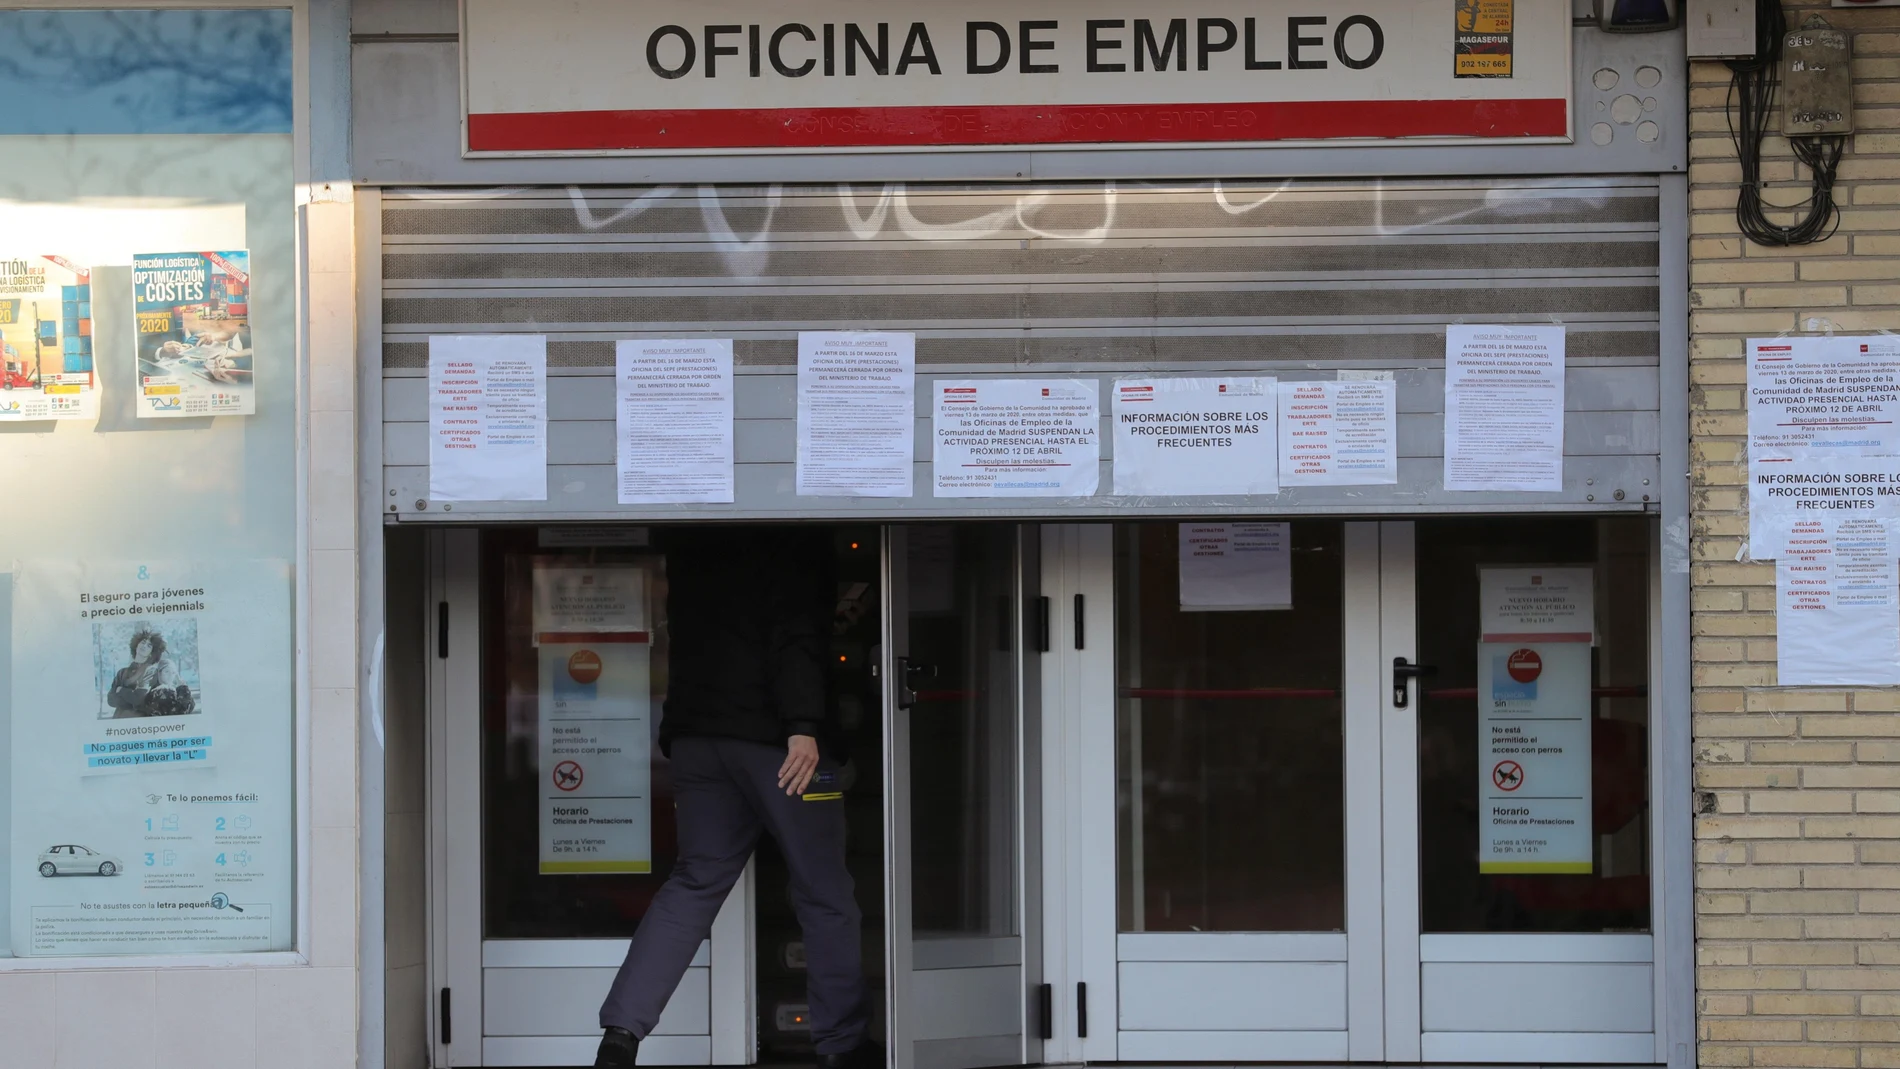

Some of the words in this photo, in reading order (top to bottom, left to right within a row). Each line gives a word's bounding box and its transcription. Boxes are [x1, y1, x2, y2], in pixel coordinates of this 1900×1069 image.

[1495, 19, 1509, 27] 24h
[1459, 36, 1509, 44] MAGASEGUR
[646, 21, 940, 79] OFICINA
[966, 20, 1058, 74] DE
[1086, 14, 1384, 72] EMPLEO
[1492, 60, 1507, 68] 665
[133, 257, 164, 271] FUNCIÓN
[164, 257, 200, 270] LOGÍSTICA
[38, 267, 46, 275] LA
[9, 275, 46, 286] LOGÍSTICA
[134, 269, 205, 286] OPTIMIZACIÓN
[146, 283, 204, 302] COSTES
[141, 319, 169, 333] 2020
[1121, 411, 1200, 423] INFORMACIÓN
[1203, 412, 1242, 422] SOBRE
[1245, 411, 1269, 421] LOS
[960, 419, 972, 427] las
[973, 419, 1007, 427] Oficinas
[1008, 419, 1019, 427] de
[1021, 418, 1052, 428] Empleo
[1053, 418, 1064, 426] de
[1065, 418, 1073, 426] la
[938, 428, 985, 437] Comunidad
[986, 428, 997, 436] de
[998, 428, 1026, 436] Madrid
[1028, 428, 1081, 436] SUSPENDAN
[1131, 424, 1231, 436] PROCEDIMIENTOS
[1234, 422, 1259, 434] MÁS
[943, 438, 989, 446] ACTIVIDAD
[991, 438, 1045, 446] PRESENCIAL
[1047, 437, 1077, 445] HASTA
[1078, 437, 1089, 445] EL
[1157, 437, 1232, 448] FRECUENTES
[970, 447, 1010, 455] PRÓXIMO
[1012, 447, 1021, 455] 12
[1023, 447, 1035, 455] DE
[1037, 447, 1063, 455] ABRIL
[976, 458, 1009, 467] Disculpen
[1023, 458, 1057, 466] molestias.
[1758, 472, 1841, 484] INFORMACIÓN
[1844, 473, 1885, 484] SOBRE
[1768, 486, 1874, 497] PROCEDIMIENTOS
[1877, 485, 1900, 498] MÁS
[1796, 499, 1875, 510] FRECUENTES
[80, 593, 90, 604] El
[93, 592, 131, 605] seguro
[134, 591, 159, 602] para
[161, 586, 205, 601] jóvenes
[81, 610, 88, 618] a
[90, 605, 126, 620] precio
[128, 604, 143, 615] de
[146, 600, 205, 616] viejennials
[1494, 698, 1508, 708] sin
[105, 723, 186, 738] #novatospower
[1492, 726, 1503, 734] No
[91, 743, 107, 753] No
[108, 741, 145, 753] pagues
[147, 739, 168, 749] más
[171, 739, 187, 750] por
[190, 737, 206, 747] ser
[1492, 736, 1529, 745] permitido
[1537, 747, 1563, 755] perros
[97, 755, 132, 766] novato
[134, 755, 140, 765] y
[143, 751, 170, 763] llevar
[172, 751, 182, 760] la
[166, 793, 177, 802] Te
[179, 794, 189, 802] lo
[190, 795, 233, 804] ponemos
[235, 793, 258, 802] fácil:
[553, 806, 589, 816] Horario
[1493, 807, 1530, 816] Horario
[145, 818, 152, 831] 1
[215, 817, 226, 831] 2
[588, 817, 633, 825] Prestaciones
[145, 852, 155, 867] 3
[215, 853, 227, 866] 4
[80, 902, 92, 910] No
[156, 901, 177, 909] letra
